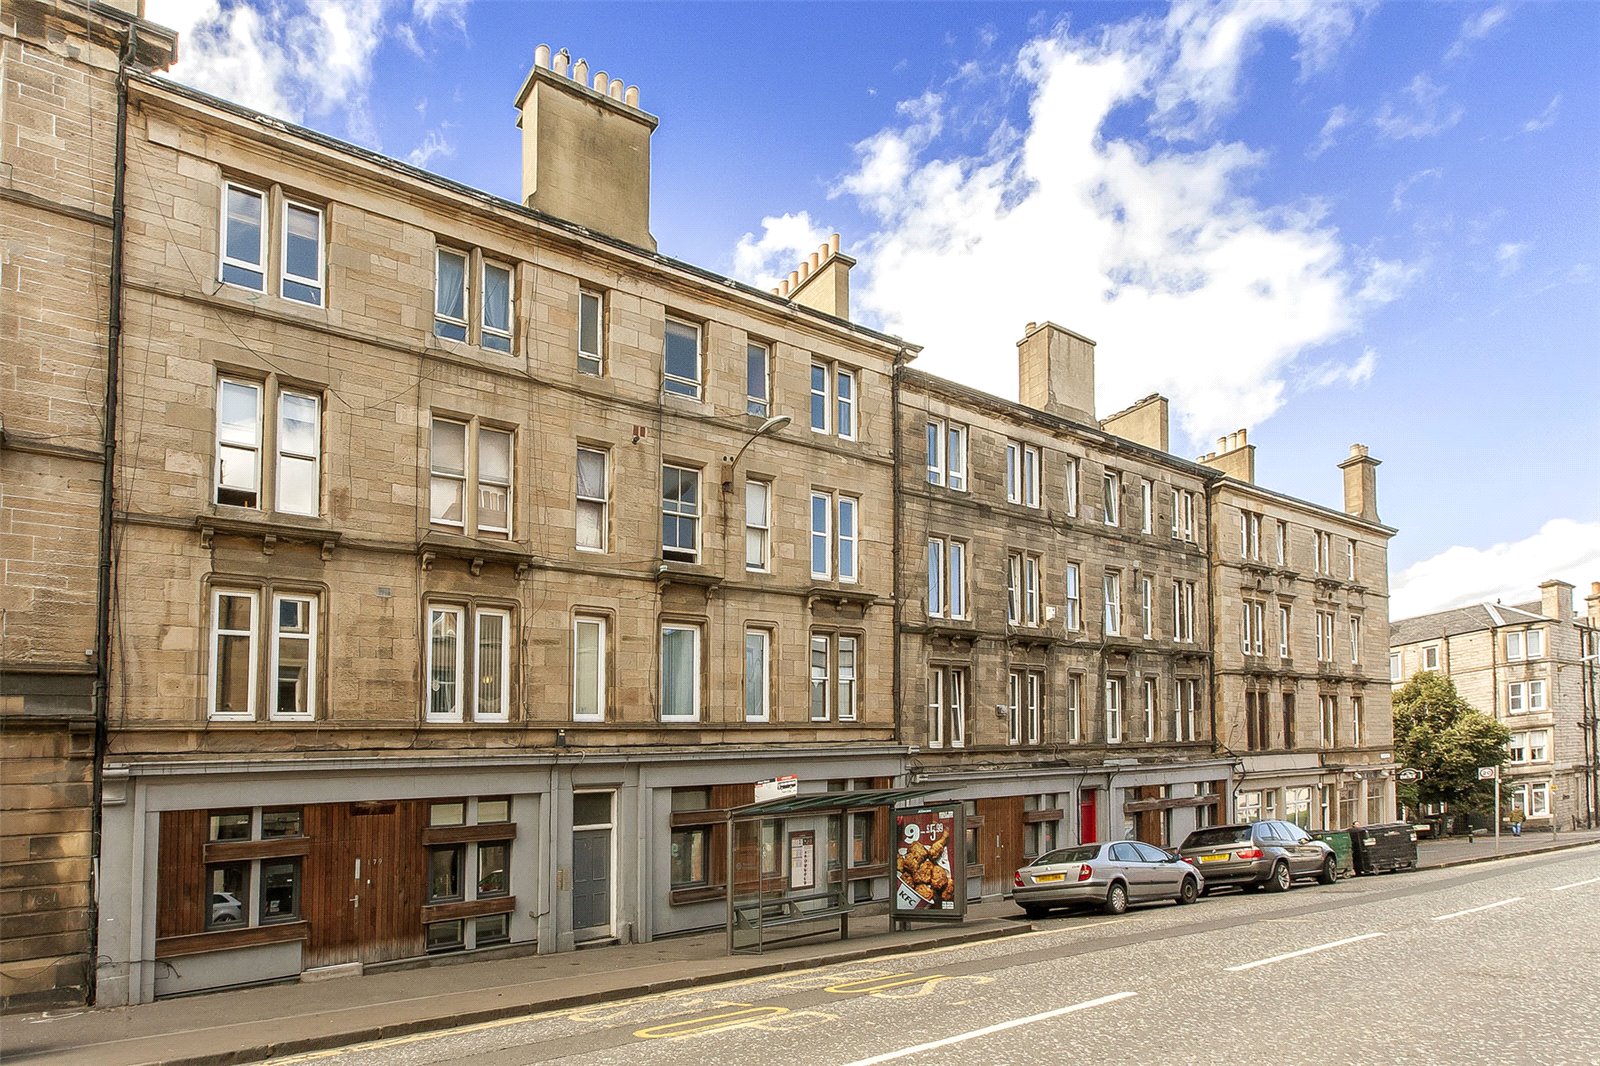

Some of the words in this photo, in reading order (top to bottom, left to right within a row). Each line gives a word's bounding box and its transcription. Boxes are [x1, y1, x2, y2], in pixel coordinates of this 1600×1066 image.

[904, 823, 920, 844] 9
[899, 890, 917, 906] KFC
[769, 969, 993, 999] BUS
